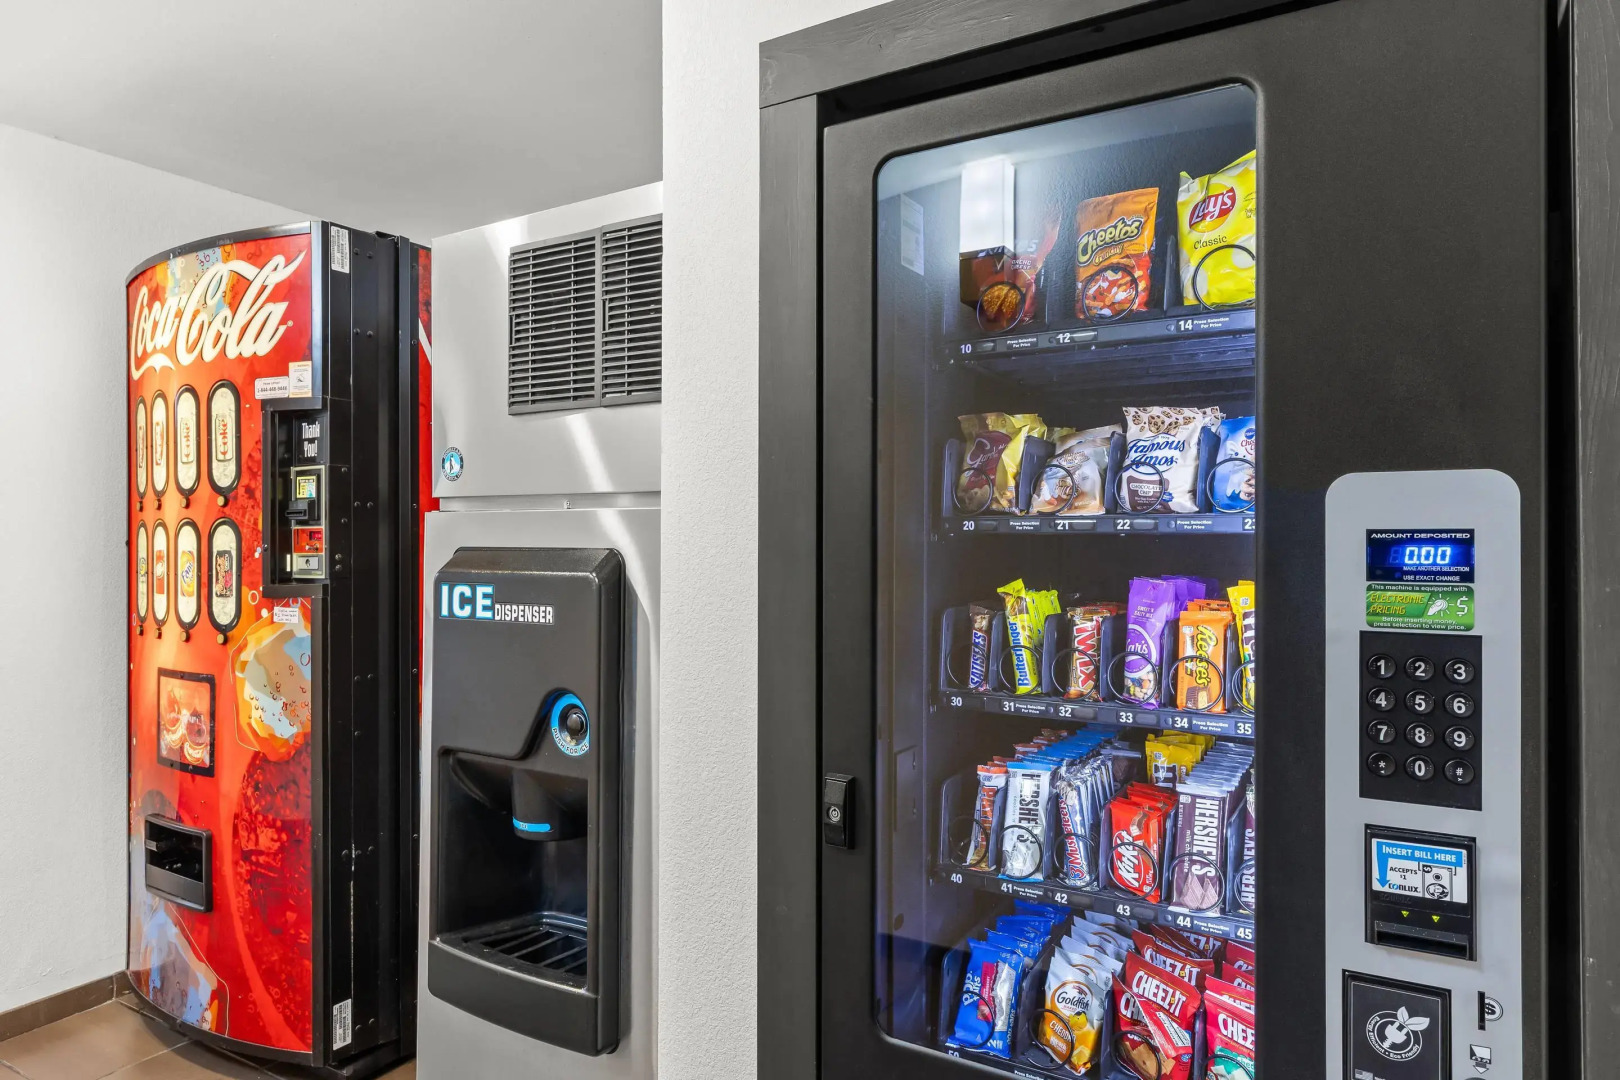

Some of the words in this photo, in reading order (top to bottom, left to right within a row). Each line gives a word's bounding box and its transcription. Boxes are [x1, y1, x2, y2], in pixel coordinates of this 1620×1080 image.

[1191, 191, 1234, 224] Lay's
[1077, 216, 1143, 266] Cheetos
[1193, 235, 1227, 250] Classic
[131, 249, 307, 380] Coca-Cola
[1179, 319, 1193, 331] 14
[1057, 332, 1071, 343] 12
[960, 344, 972, 354] 10
[302, 421, 320, 439] Thank
[304, 440, 318, 457] You!
[1127, 439, 1186, 455] Famous
[1131, 453, 1174, 468] Amos
[962, 520, 975, 531] 20
[1057, 520, 1069, 530] 21
[1116, 519, 1131, 530] 22
[1404, 546, 1451, 564] 0.00
[440, 583, 494, 619] ICE
[494, 603, 553, 623] DISPENSER
[1370, 593, 1426, 604] ELECTRONIC
[1370, 605, 1406, 615] PRICING
[1404, 617, 1433, 625] inserting
[1008, 621, 1031, 687] Butterfnger
[1074, 616, 1101, 687] TWIX
[1195, 625, 1218, 687] Reese's
[1377, 659, 1385, 675] 1
[1414, 661, 1426, 677] 2
[1453, 663, 1466, 680] 3
[950, 696, 963, 707] 30
[1003, 701, 1014, 712] 31
[1375, 691, 1387, 708] 4
[1414, 695, 1426, 711] 5
[1453, 697, 1466, 714] 6
[1058, 706, 1072, 717] 32
[1119, 712, 1133, 723] 33
[1174, 717, 1189, 729] 34
[1236, 722, 1252, 735] 35
[1377, 725, 1388, 741] 7
[1414, 727, 1426, 744] 8
[1453, 731, 1466, 747] 9
[552, 727, 566, 749] PUSH
[566, 746, 579, 755] FOR
[580, 741, 589, 753] ICE
[1414, 760, 1426, 777] 0
[1382, 844, 1413, 857] INSERT
[1414, 849, 1432, 860] BILL
[1434, 853, 1457, 863] HERE
[1069, 866, 1086, 879] 3
[1389, 866, 1418, 875] ACCEPTS
[950, 873, 963, 884] 40
[1001, 882, 1013, 894] 41
[1054, 892, 1068, 904] 42
[1117, 904, 1131, 916] 43
[1176, 916, 1191, 928] 44
[1236, 927, 1253, 940] 45
[1057, 991, 1090, 1011] Goldfish
